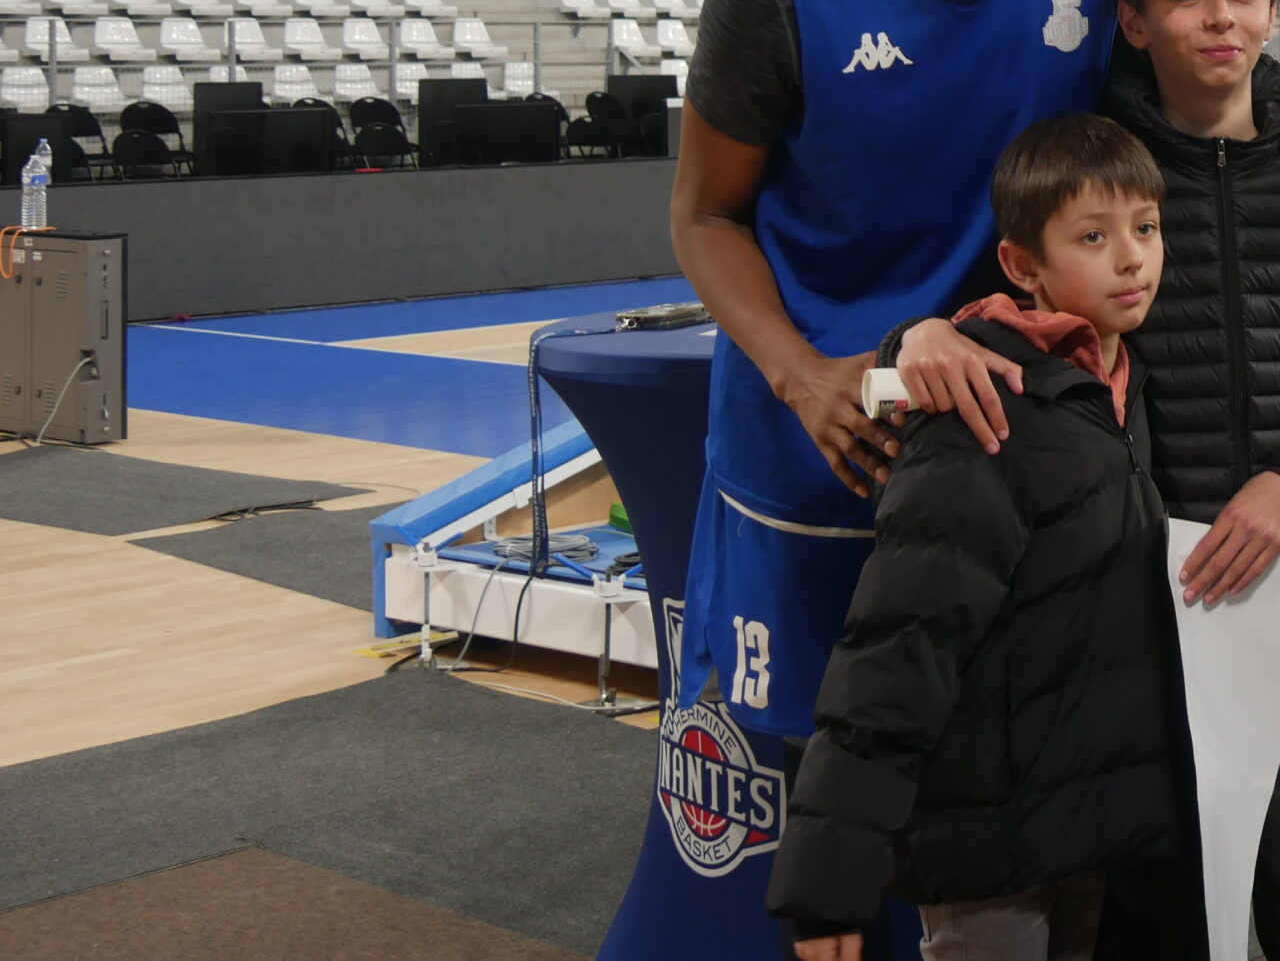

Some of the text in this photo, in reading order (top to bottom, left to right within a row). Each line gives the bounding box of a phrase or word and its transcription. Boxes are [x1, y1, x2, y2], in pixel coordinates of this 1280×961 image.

[731, 615, 770, 709] 13
[674, 710, 736, 755] HERMINE
[661, 739, 774, 829] NANTES
[676, 816, 732, 862] BASKET
